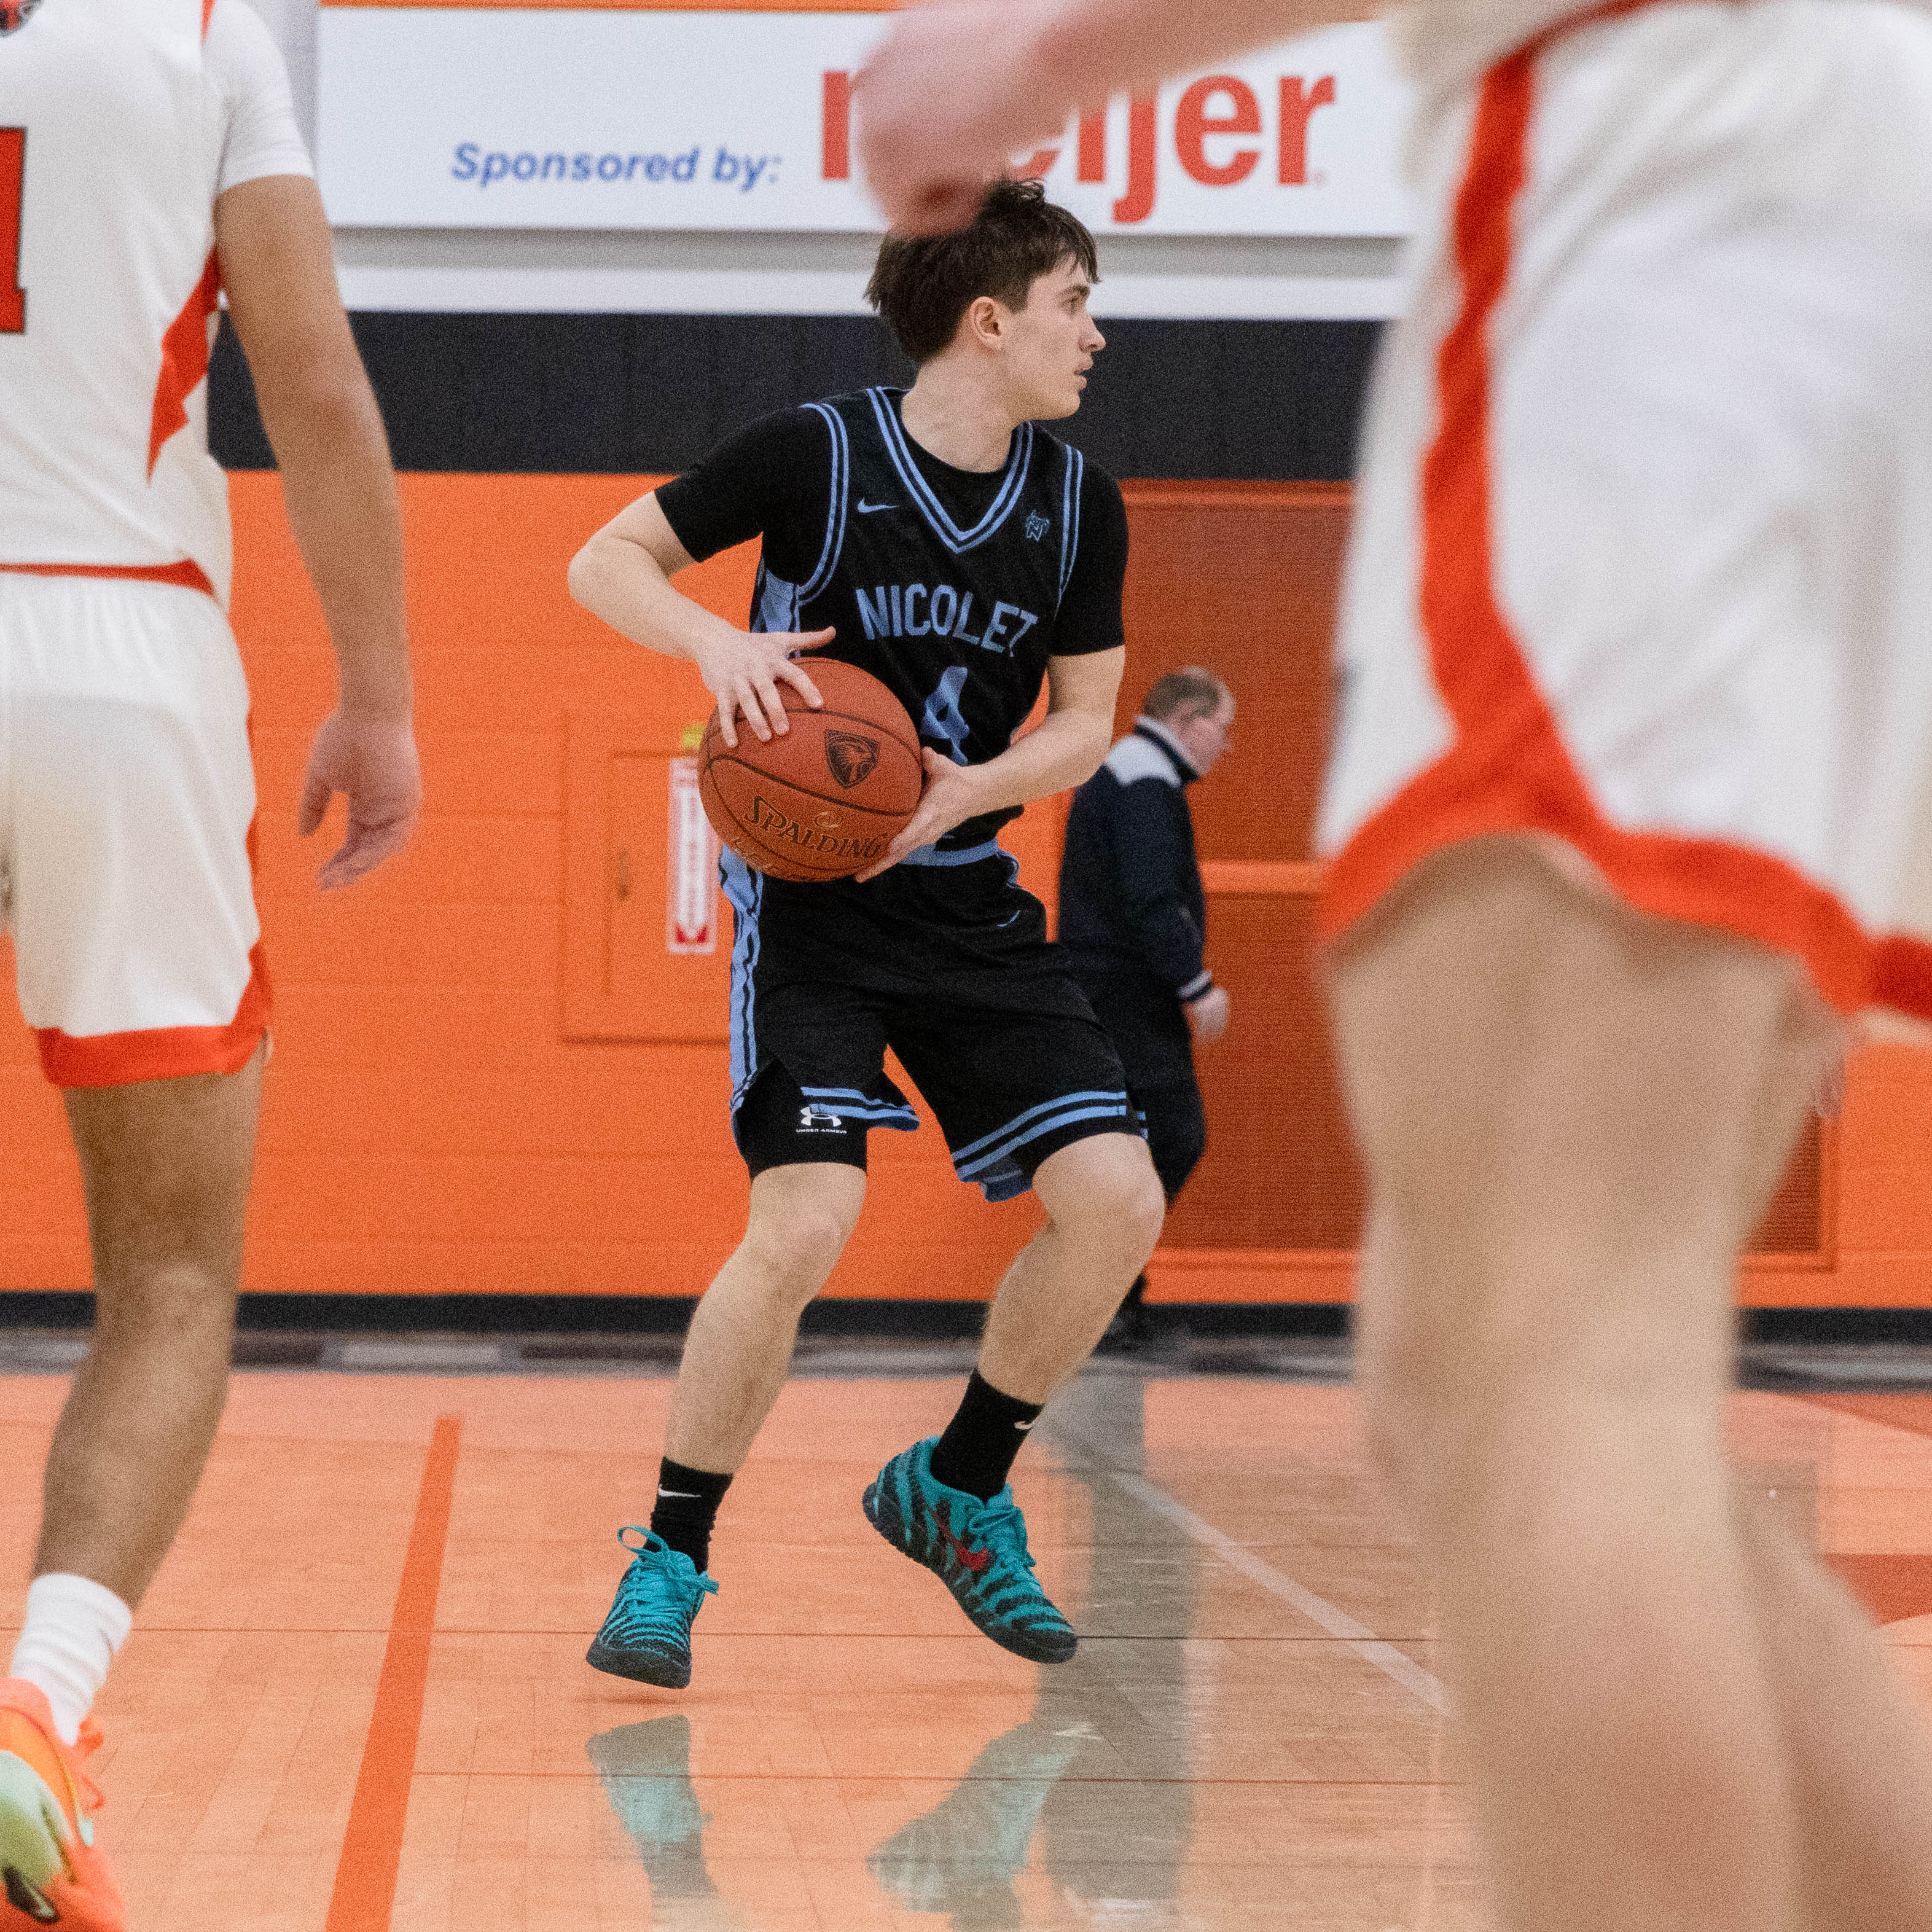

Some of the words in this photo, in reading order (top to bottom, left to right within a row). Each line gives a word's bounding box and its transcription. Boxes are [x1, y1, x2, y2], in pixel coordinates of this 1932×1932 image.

[451, 142, 700, 188] Sponsored
[713, 146, 781, 193] by:
[856, 583, 1039, 657] NICOLET
[923, 666, 970, 767] 4
[745, 796, 888, 858] SPALDING
